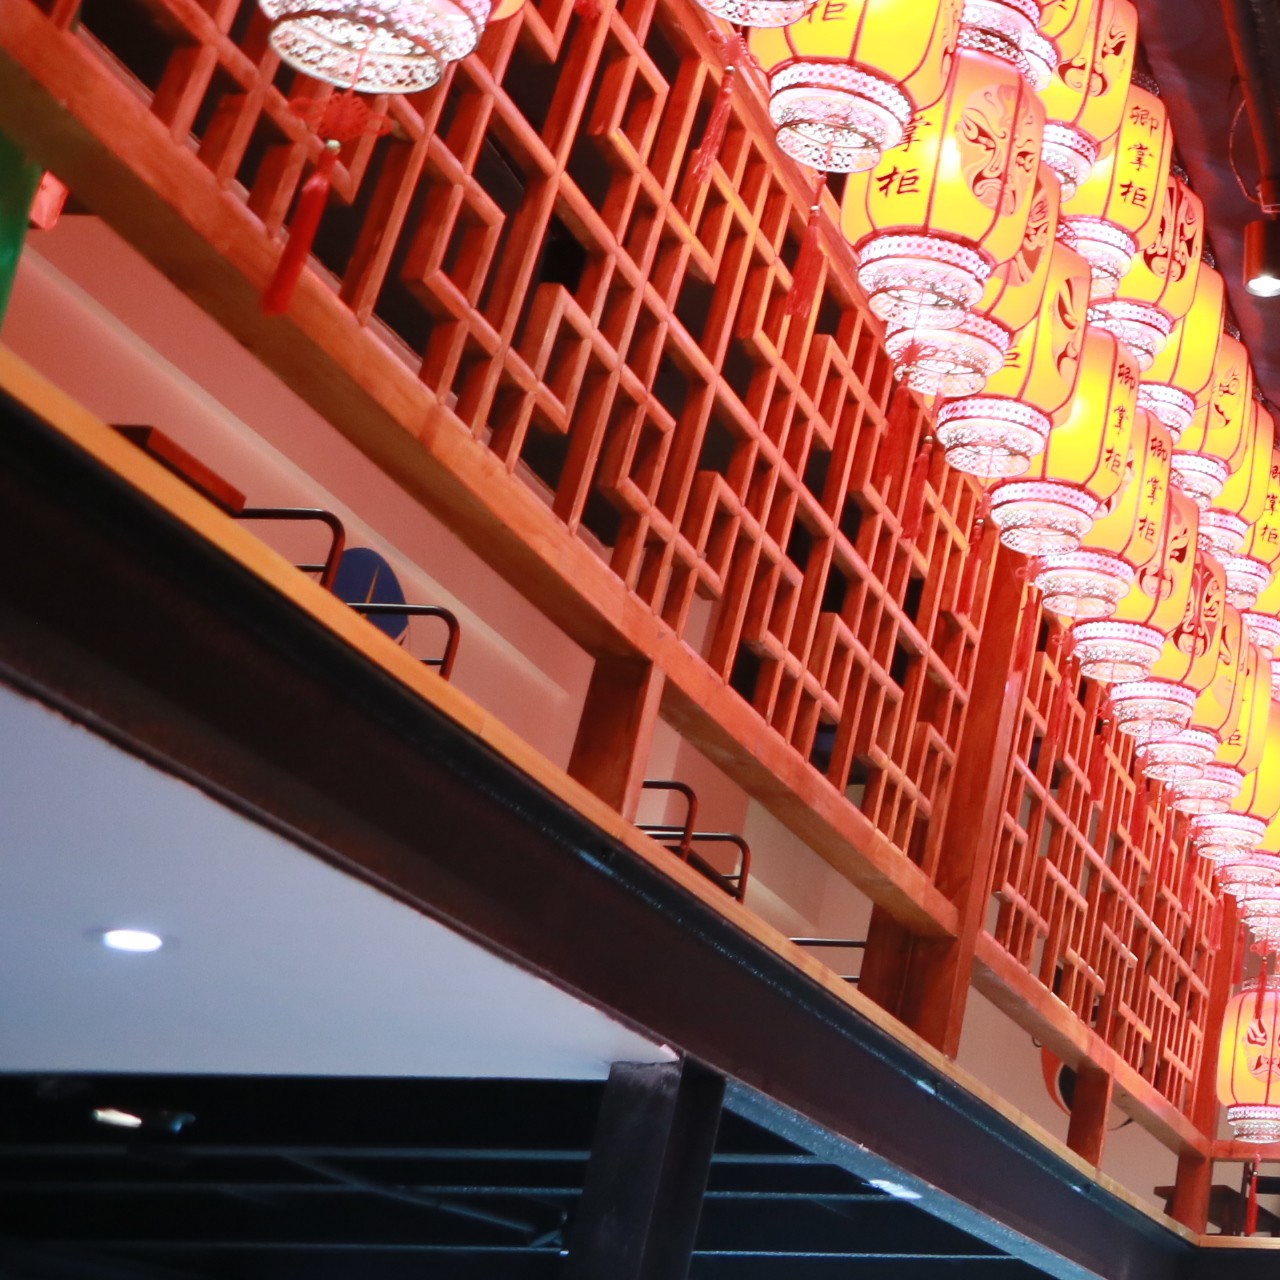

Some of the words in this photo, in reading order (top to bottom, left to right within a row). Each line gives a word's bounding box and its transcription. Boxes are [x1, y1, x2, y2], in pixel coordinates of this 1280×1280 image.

[1119, 105, 1160, 209] 卿掌柜
[1105, 363, 1136, 476] 卿掌柜
[1138, 436, 1168, 544] 卿掌柜
